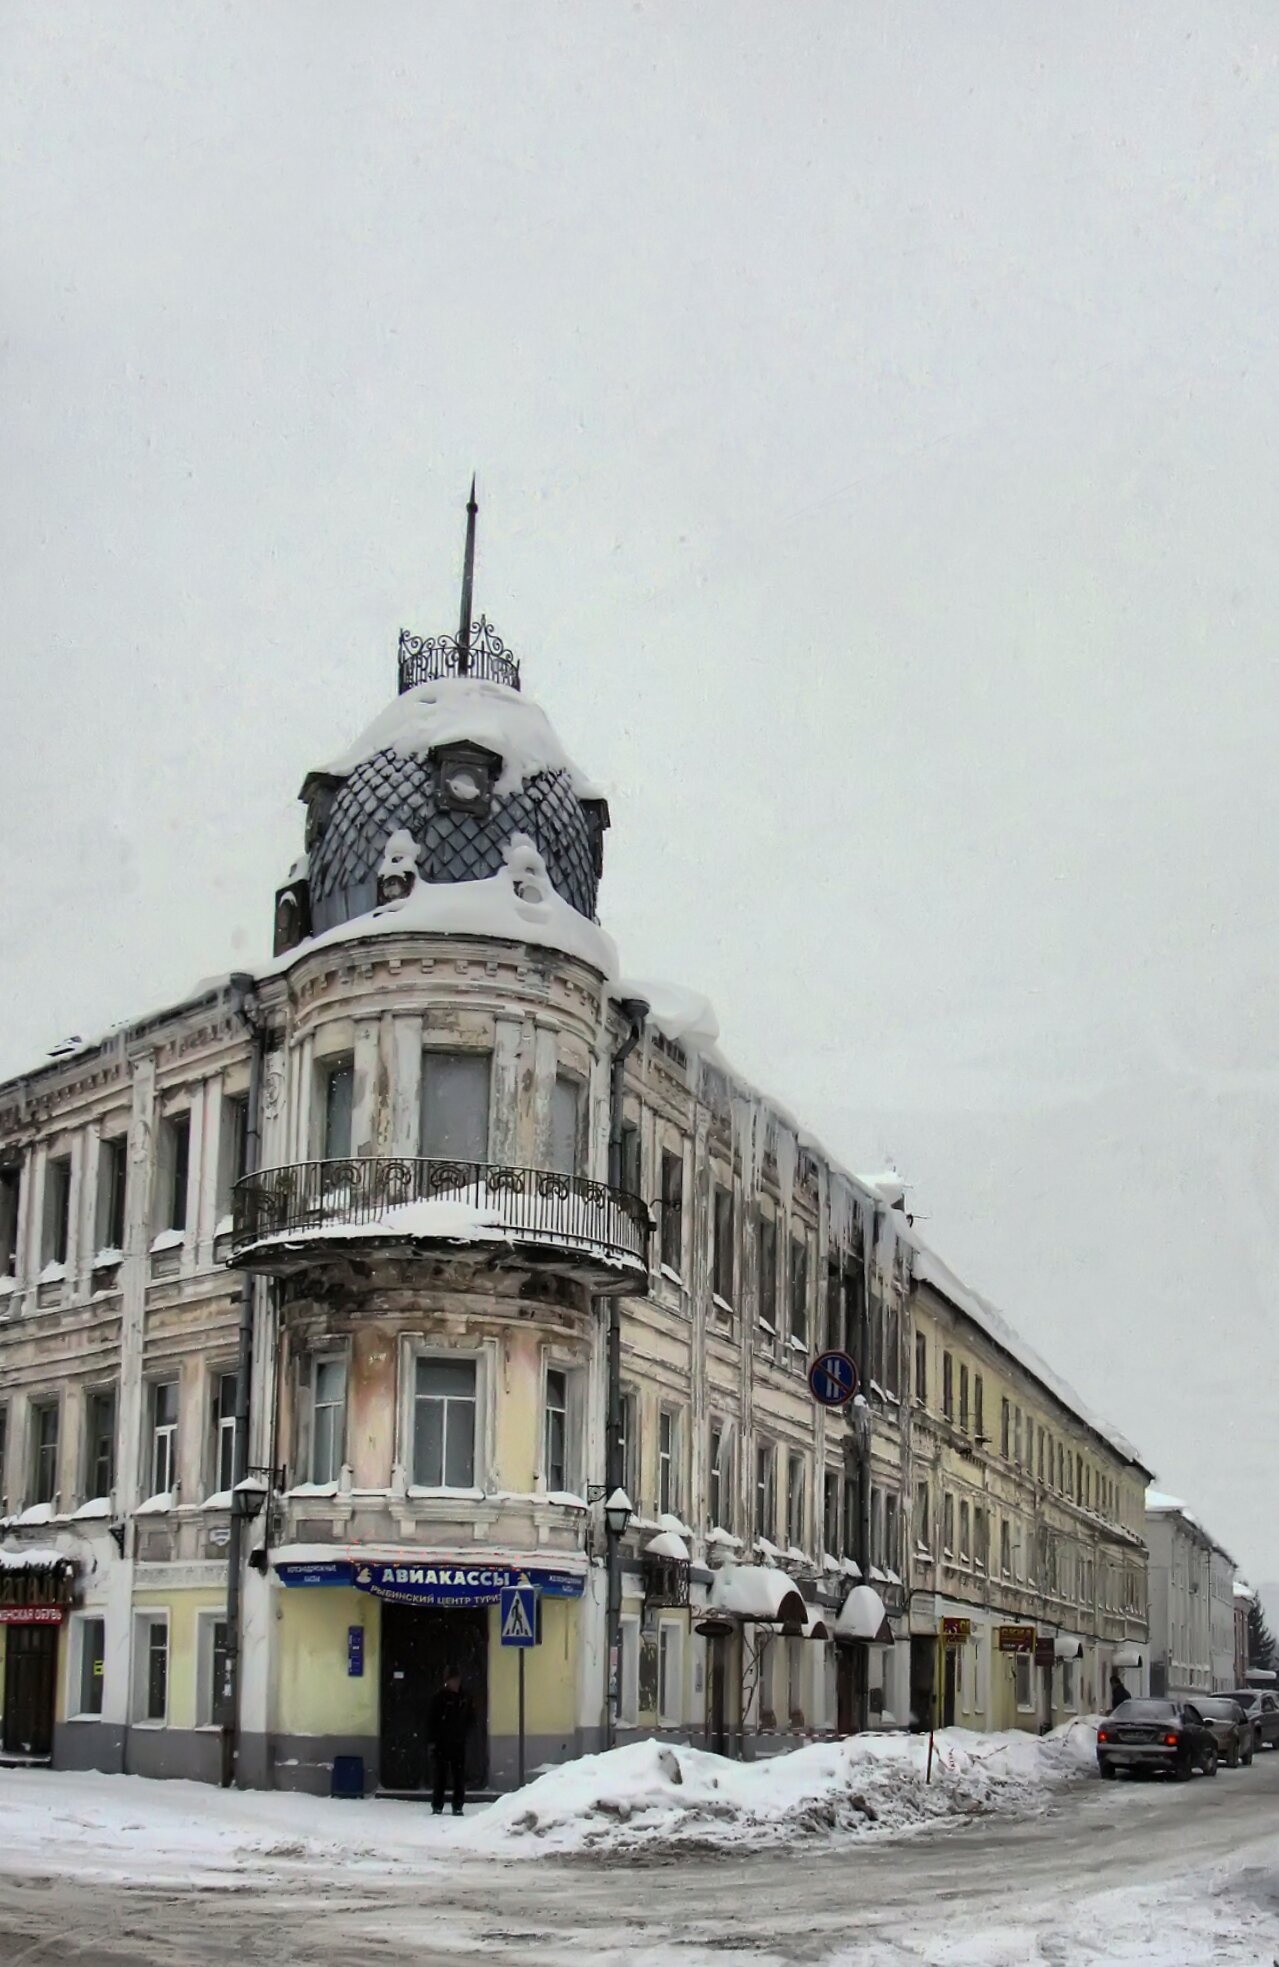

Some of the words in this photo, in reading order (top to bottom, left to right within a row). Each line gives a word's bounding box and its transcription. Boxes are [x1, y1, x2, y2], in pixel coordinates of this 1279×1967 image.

[382, 1568, 510, 1587] АВИАКАССЫ
[370, 1585, 434, 1604] РЫБИНСКИЙ
[437, 1596, 471, 1606] ЦЕНТР
